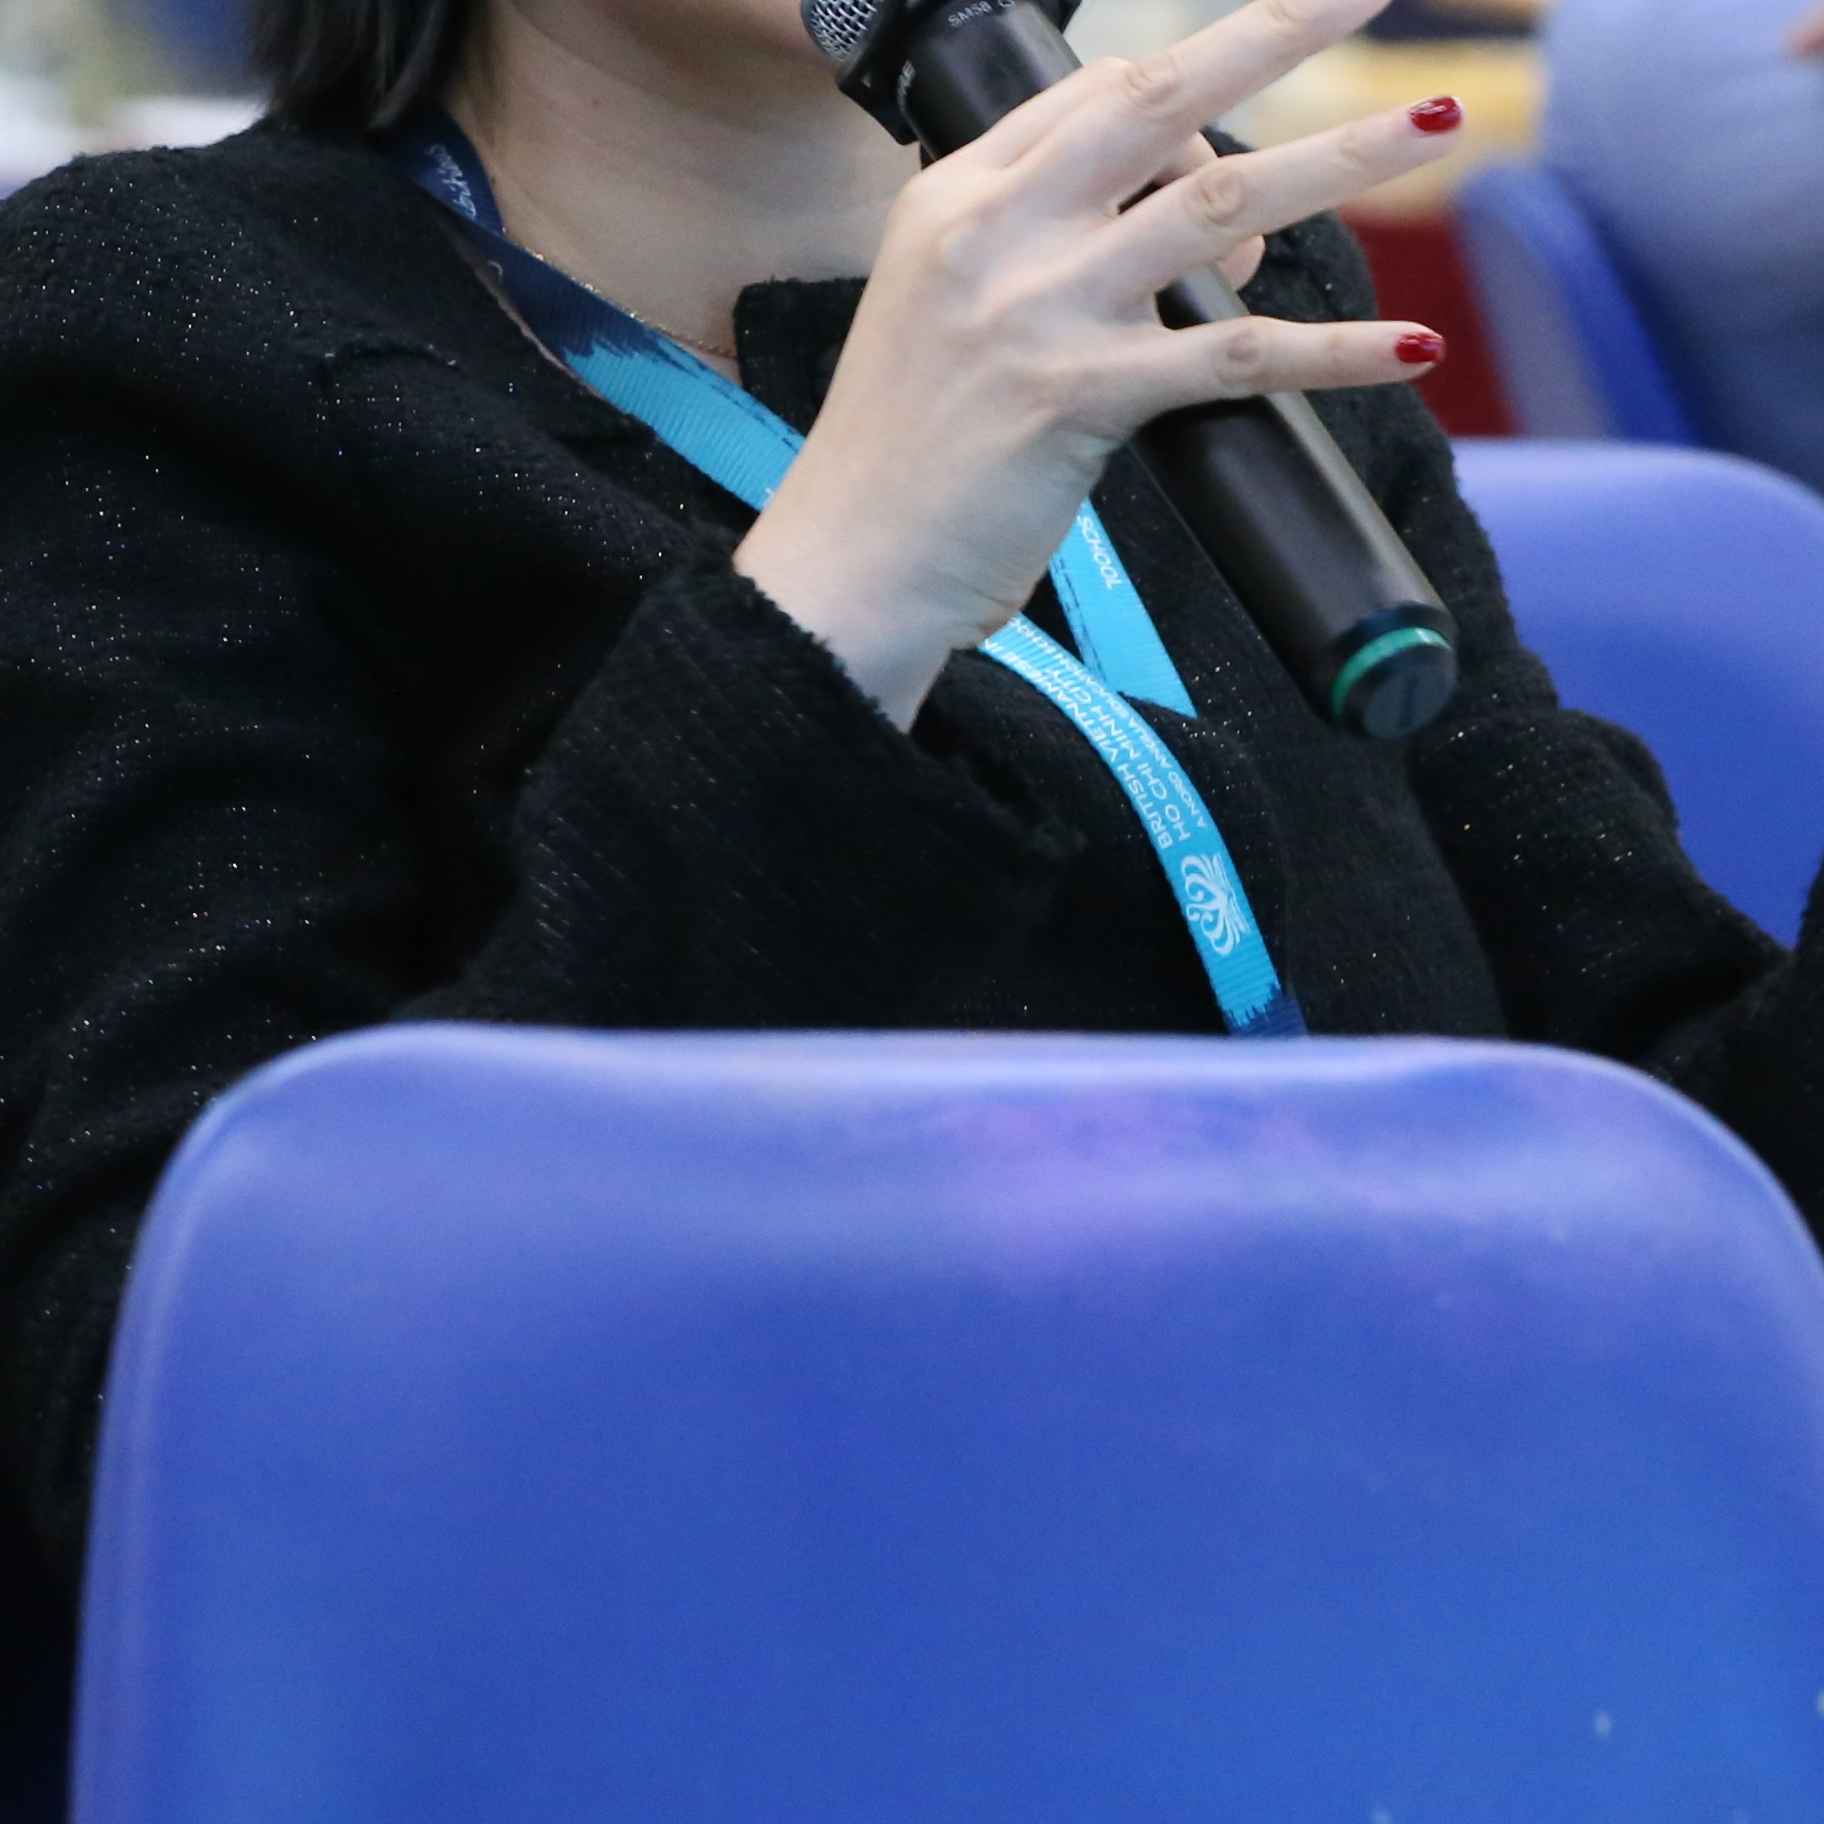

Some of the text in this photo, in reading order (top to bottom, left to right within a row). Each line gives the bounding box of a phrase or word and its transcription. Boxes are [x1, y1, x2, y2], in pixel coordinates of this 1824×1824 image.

[1076, 515, 1122, 590] SCHOOL
[1089, 705, 1140, 760] MINH
[1117, 763, 1173, 849] BRITISH
[1137, 762, 1167, 800] CHI
[1165, 804, 1191, 841] HO
